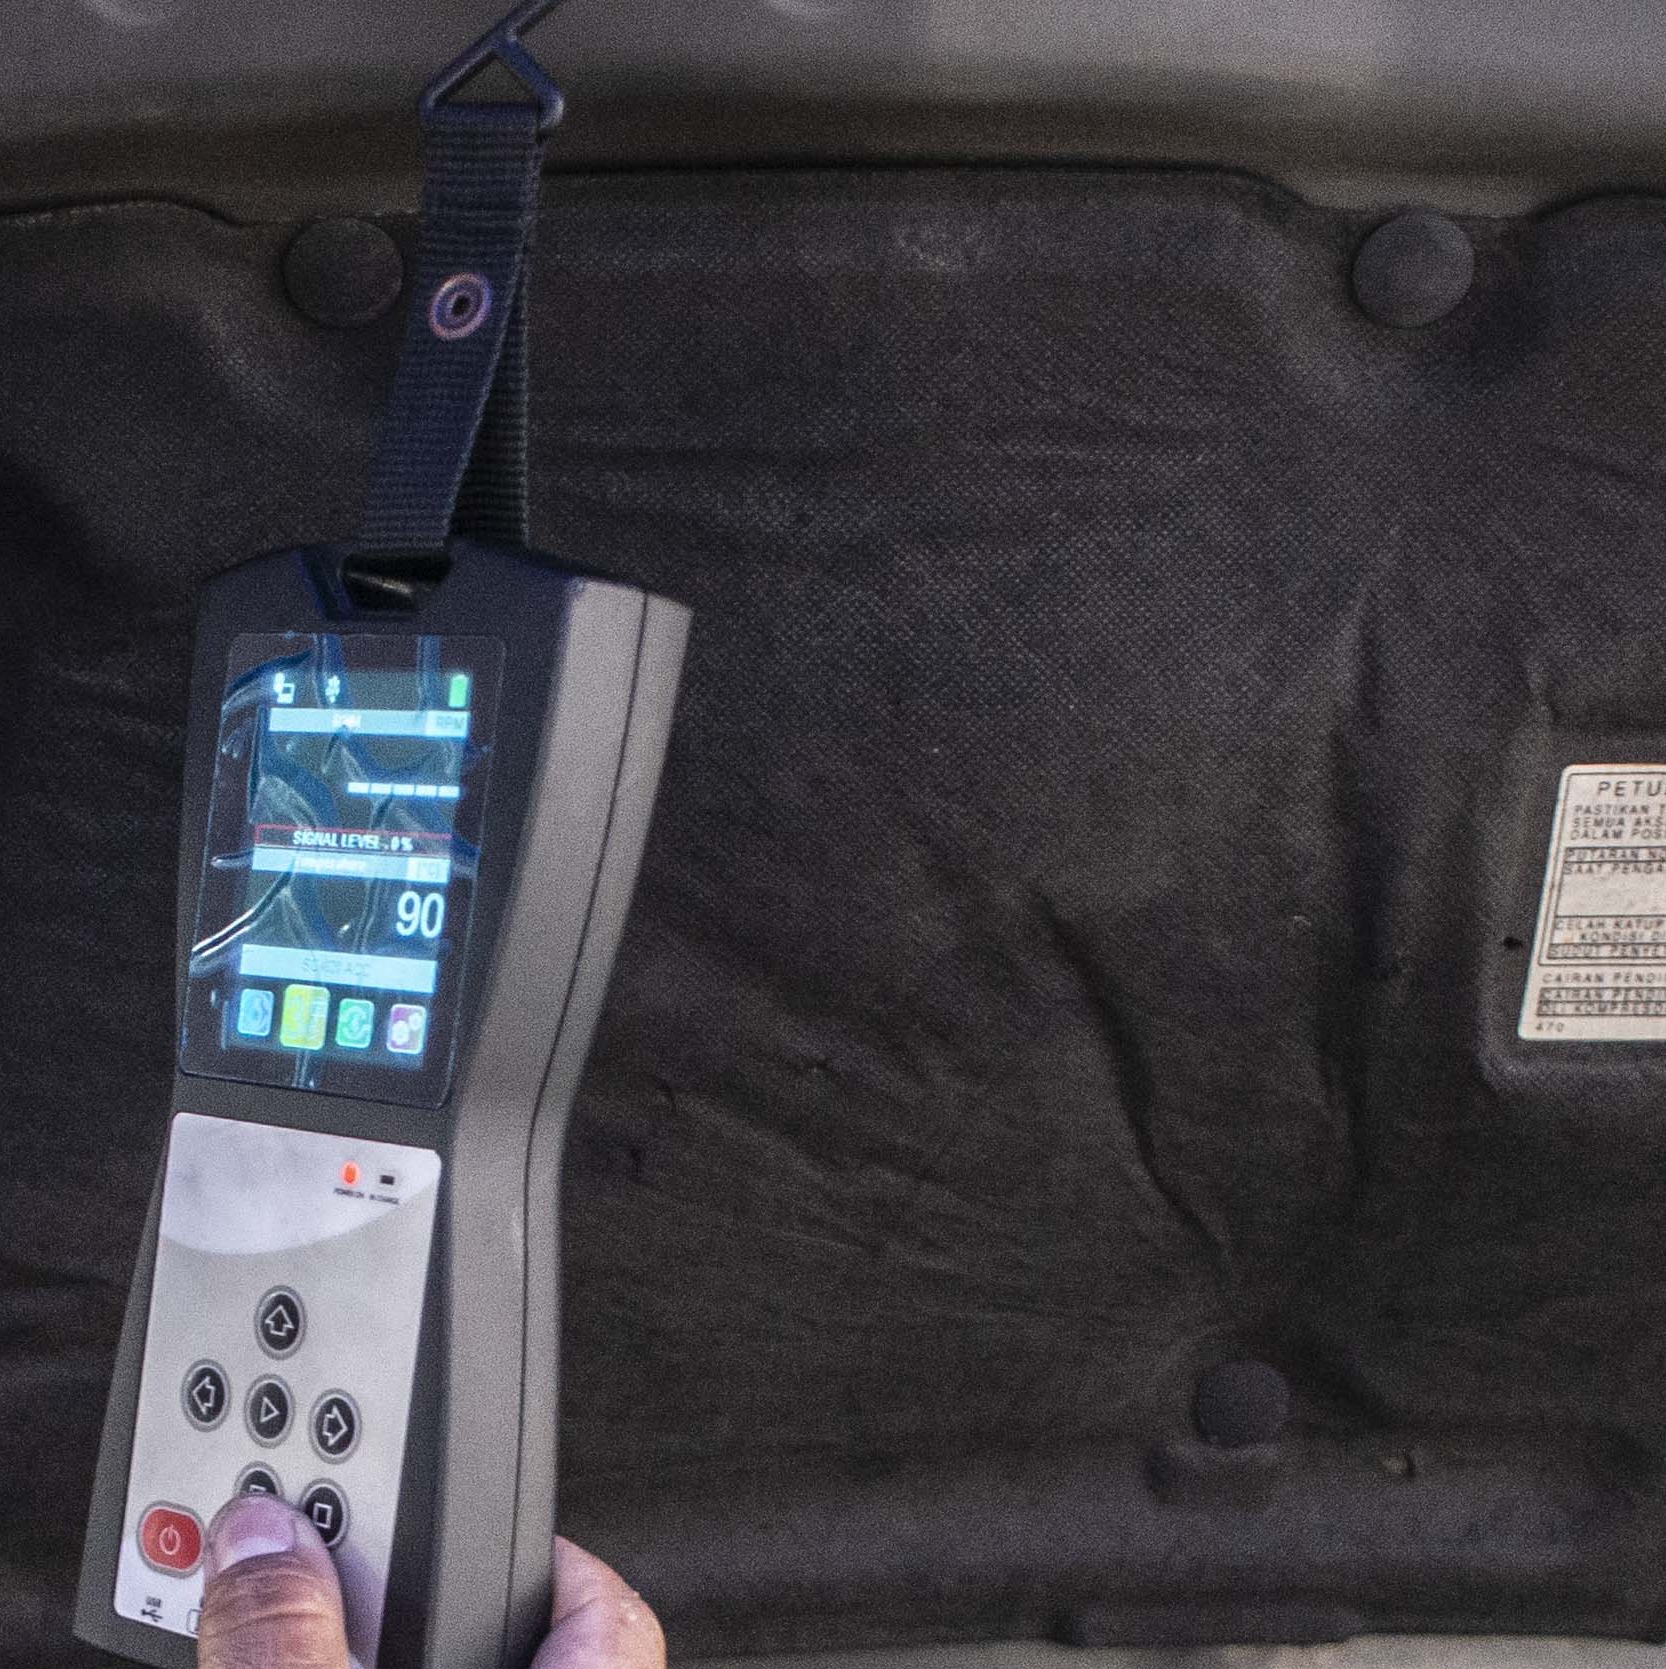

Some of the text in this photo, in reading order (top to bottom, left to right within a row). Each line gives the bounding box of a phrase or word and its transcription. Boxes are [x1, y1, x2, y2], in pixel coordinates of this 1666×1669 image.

[1574, 804, 1649, 815] PASTIKAN
[1573, 817, 1625, 828] SEMUA
[292, 830, 338, 848] SIGNAL
[1571, 829, 1623, 840] DALAM
[1565, 849, 1643, 860] PUTARAN
[1564, 863, 1603, 874] SAAT
[396, 890, 445, 938] 90
[1554, 918, 1664, 930] CELAH KATUP
[1542, 972, 1604, 984] CAIRAN
[1541, 989, 1604, 1000] CAIRAN
